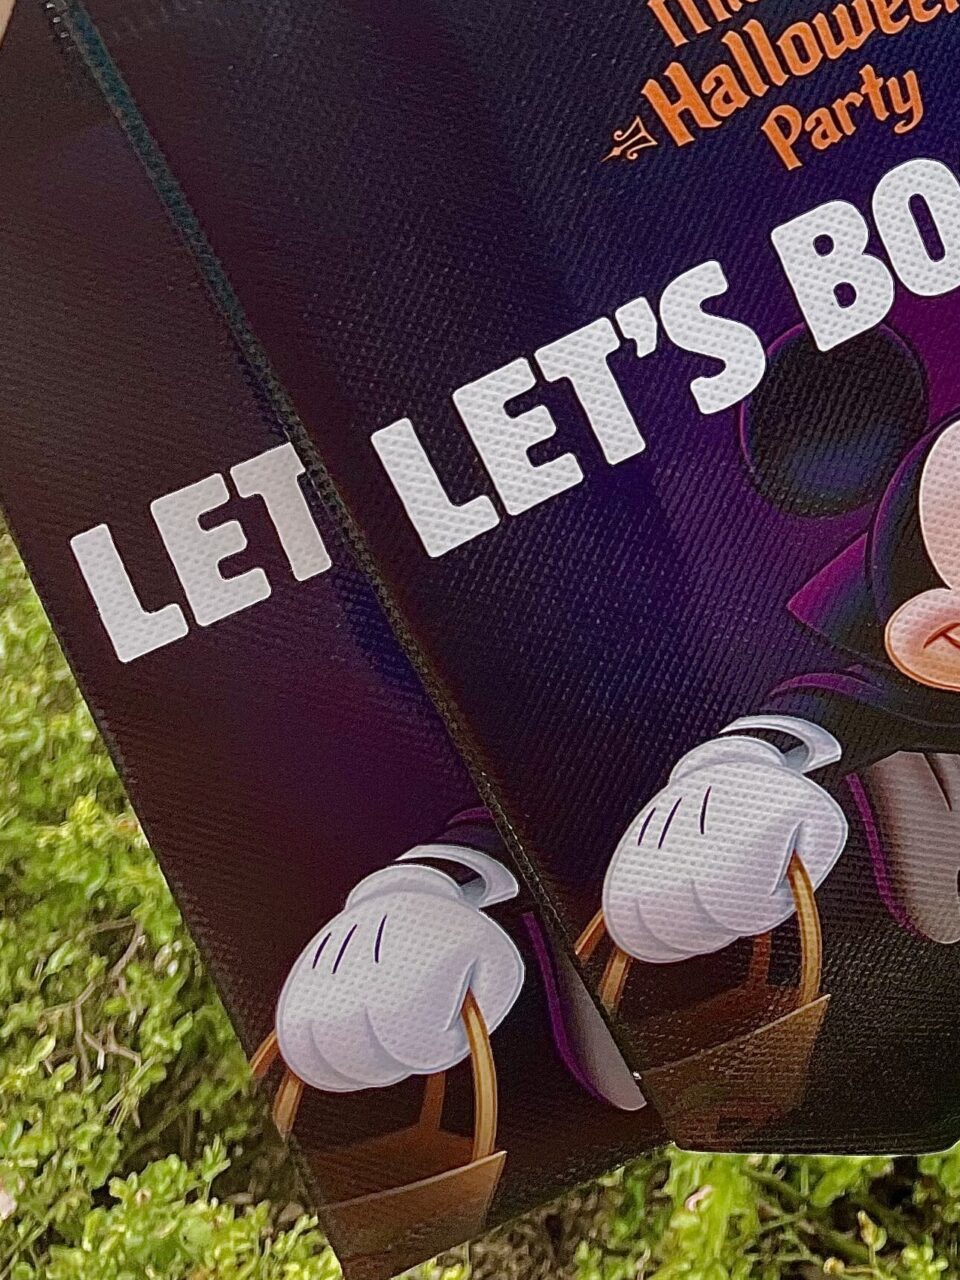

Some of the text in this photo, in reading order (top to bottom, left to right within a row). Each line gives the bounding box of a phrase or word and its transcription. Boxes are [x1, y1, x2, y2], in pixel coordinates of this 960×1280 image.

[760, 64, 924, 171] Party
[370, 260, 766, 558] LET'S
[69, 441, 333, 664] LET
